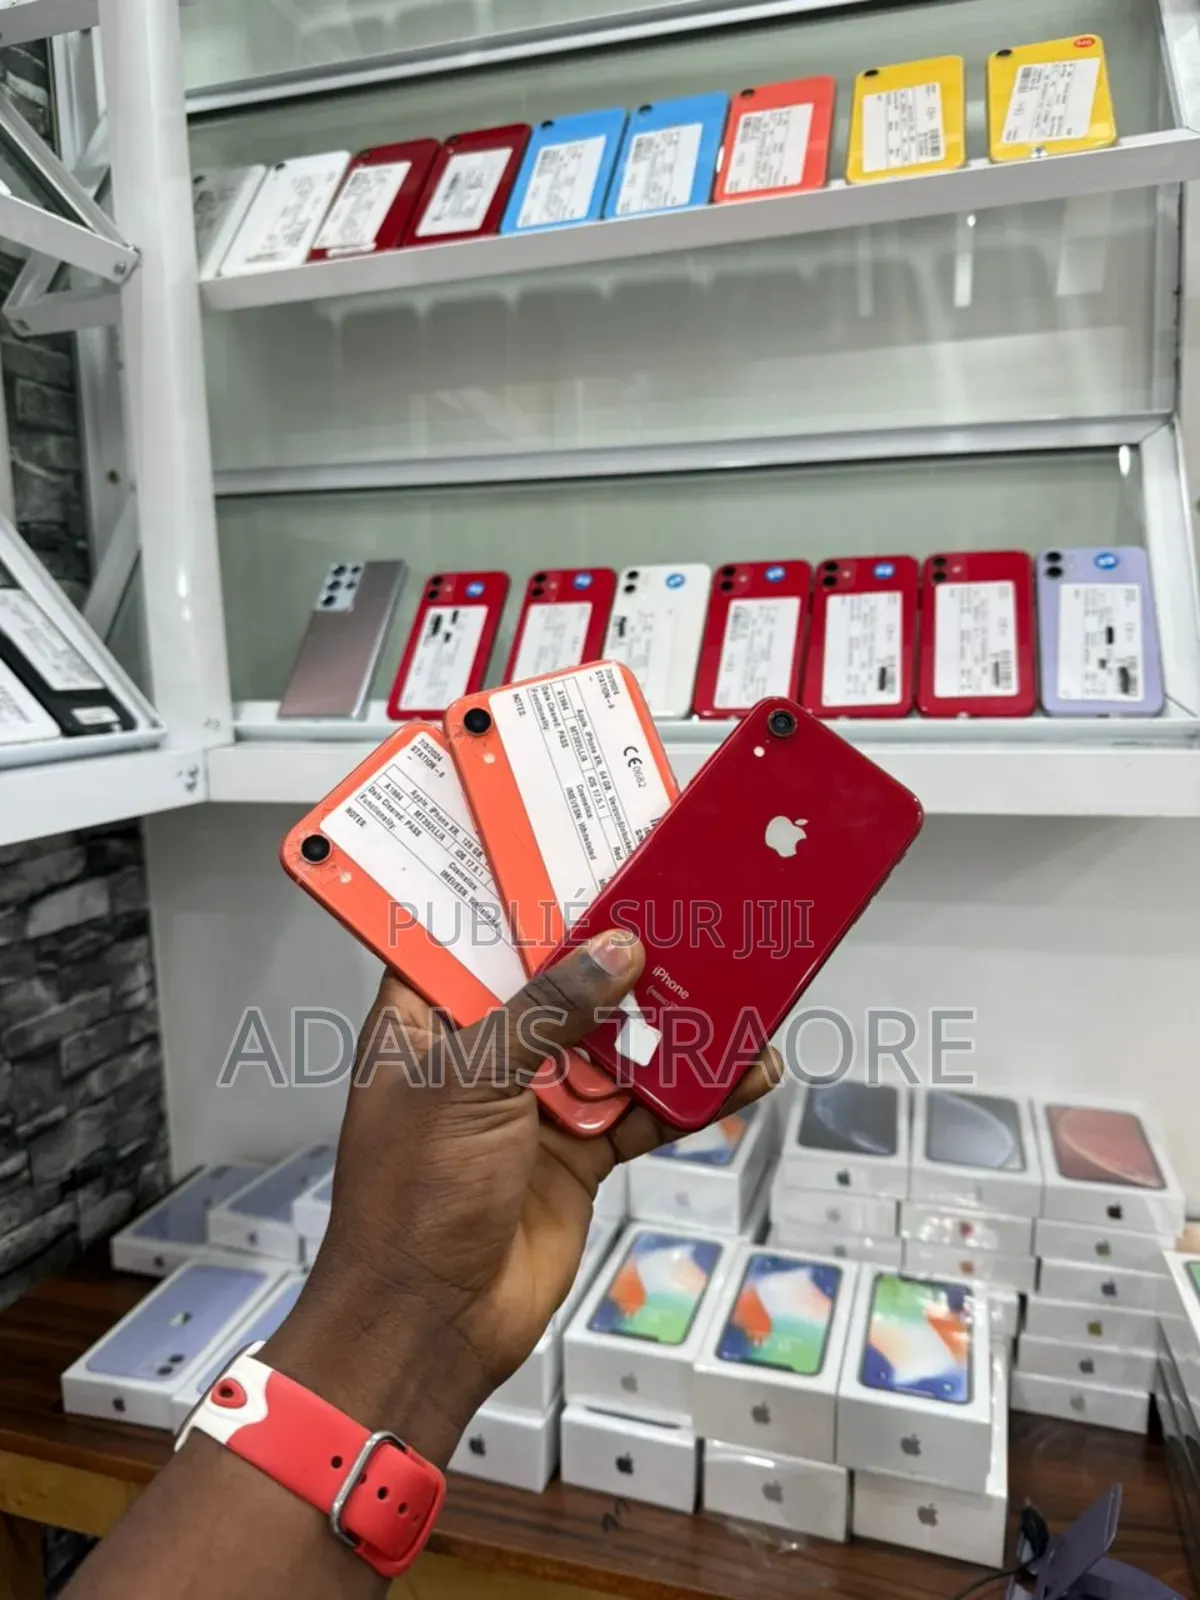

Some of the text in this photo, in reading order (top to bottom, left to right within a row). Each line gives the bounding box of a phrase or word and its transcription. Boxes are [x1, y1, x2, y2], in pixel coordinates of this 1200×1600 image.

[595, 669, 611, 699] STATION
[540, 684, 552, 701] Data
[556, 728, 569, 748] PASS
[584, 730, 598, 753] iPhone
[410, 745, 436, 769] STATION
[368, 786, 382, 800] Data
[404, 820, 421, 836] PASS
[429, 806, 449, 826] iPhone
[612, 845, 623, 861] Red
[652, 965, 690, 1000] iPhone
